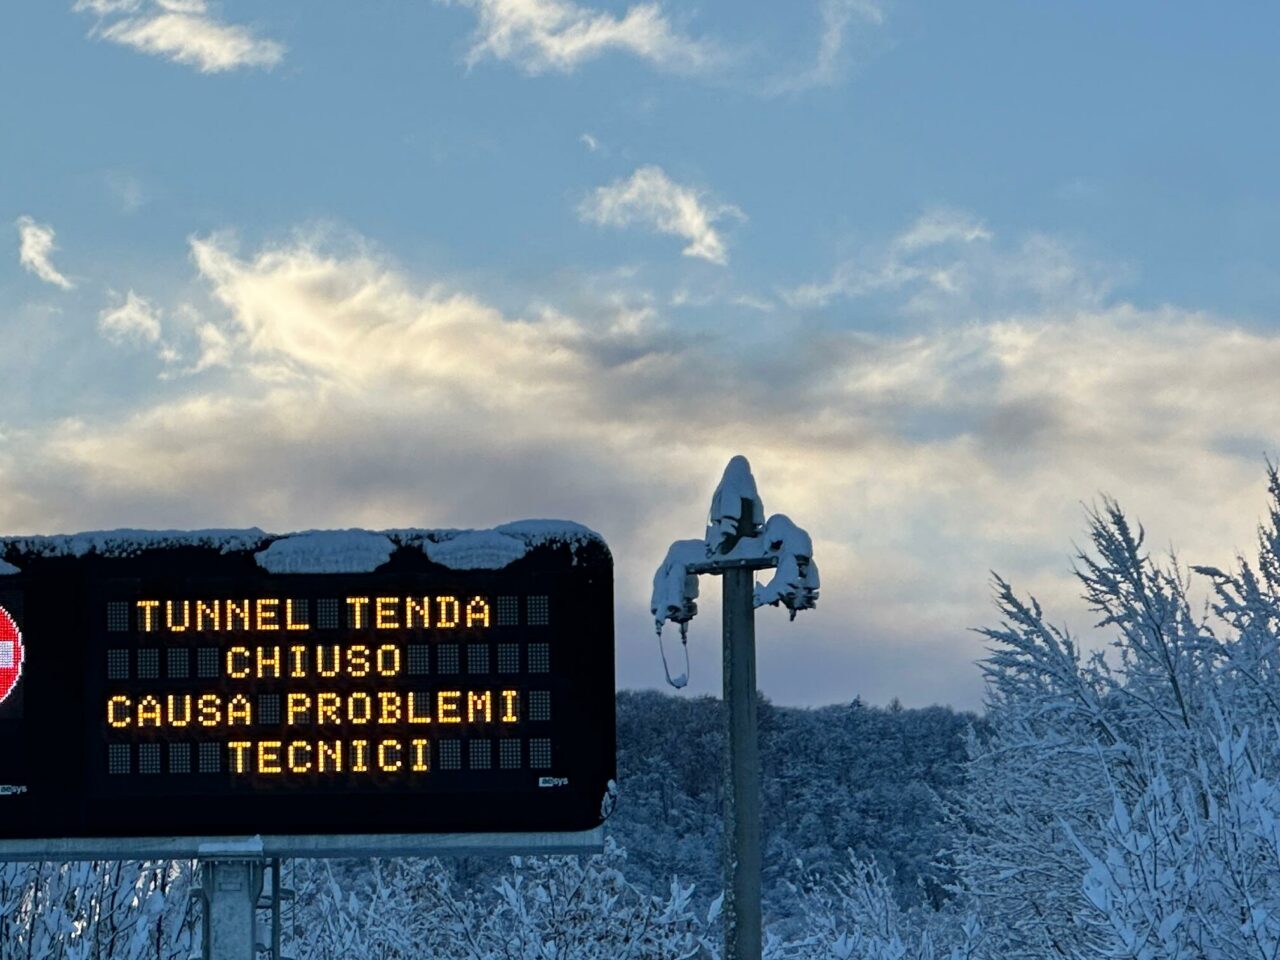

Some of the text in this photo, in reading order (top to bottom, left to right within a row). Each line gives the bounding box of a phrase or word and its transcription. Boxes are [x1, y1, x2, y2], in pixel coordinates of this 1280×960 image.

[137, 595, 491, 632] TUNNEL TENDA
[227, 644, 401, 679] CHIUSO
[107, 690, 518, 728] CAUSA PROBLEMI
[228, 739, 429, 774] TECNICI
